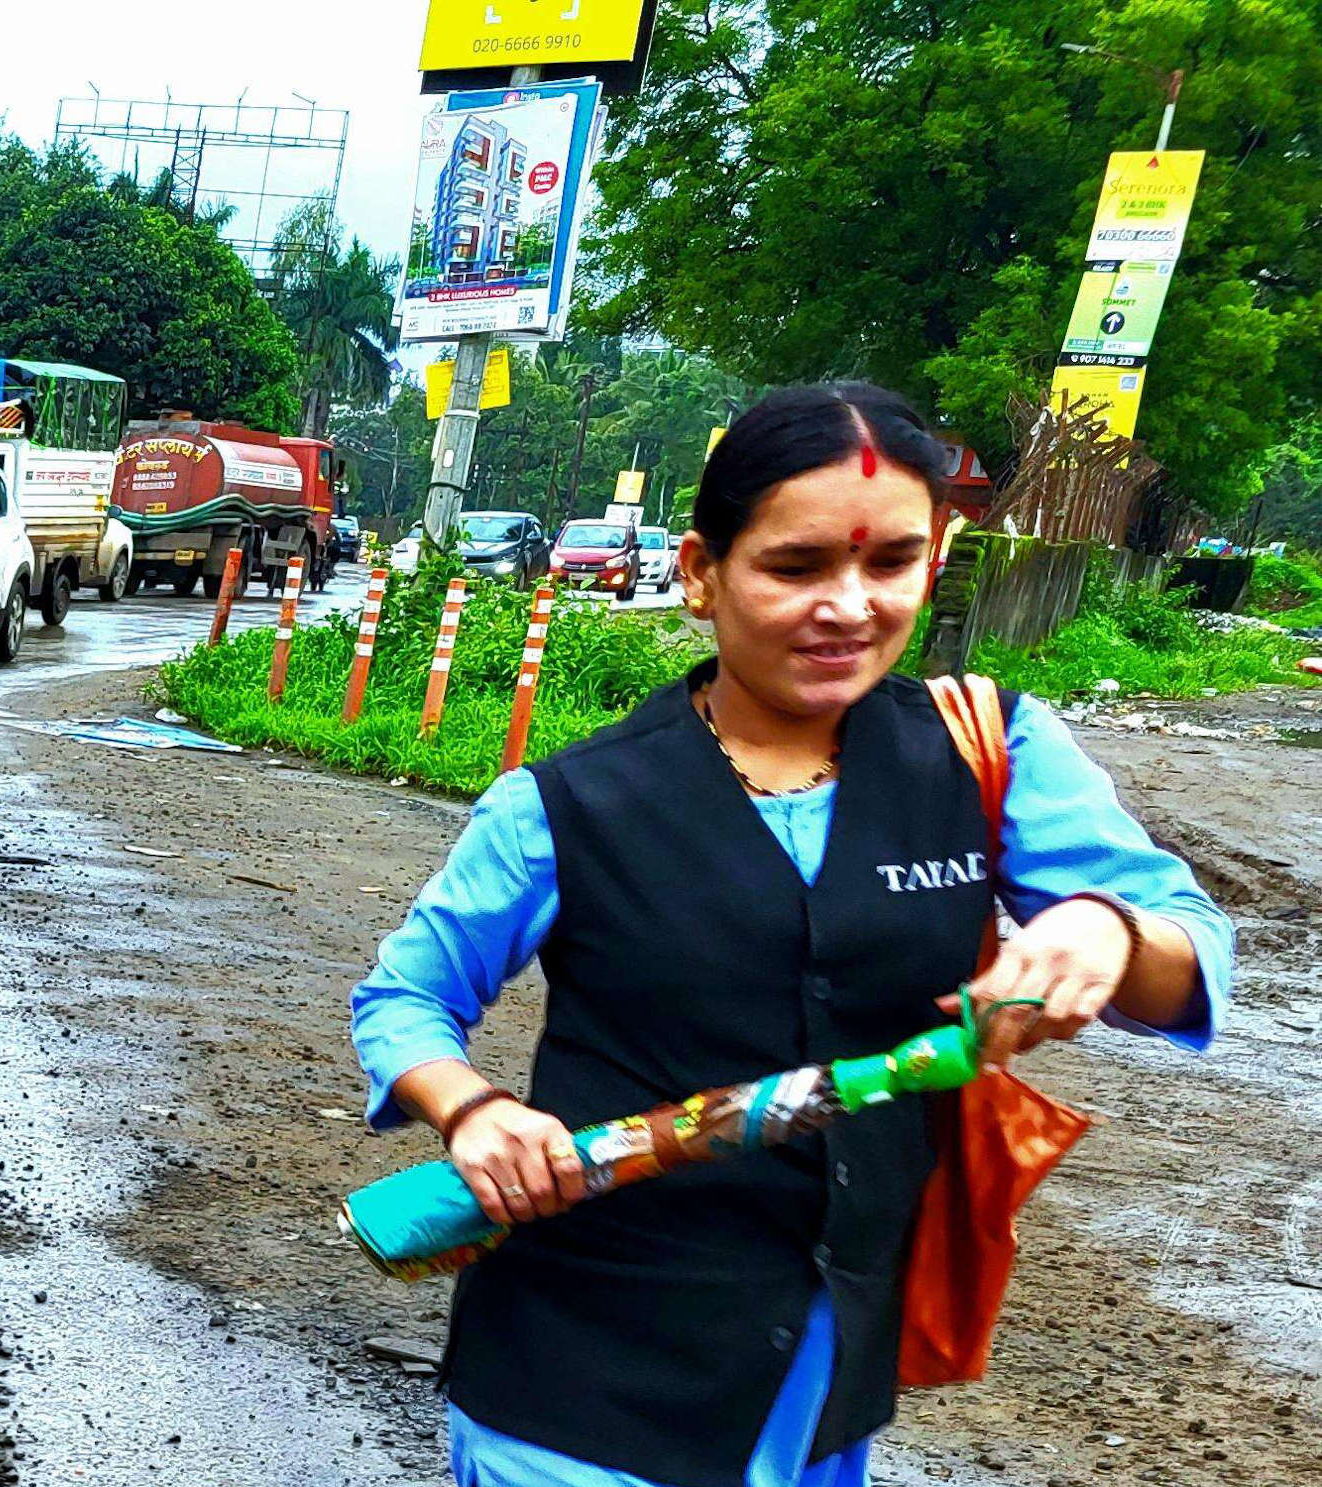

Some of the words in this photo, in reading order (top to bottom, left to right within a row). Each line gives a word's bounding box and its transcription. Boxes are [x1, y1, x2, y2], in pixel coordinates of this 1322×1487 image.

[473, 36, 540, 53] 020-6666
[545, 34, 582, 49] 9910
[1080, 355, 1097, 363] 907
